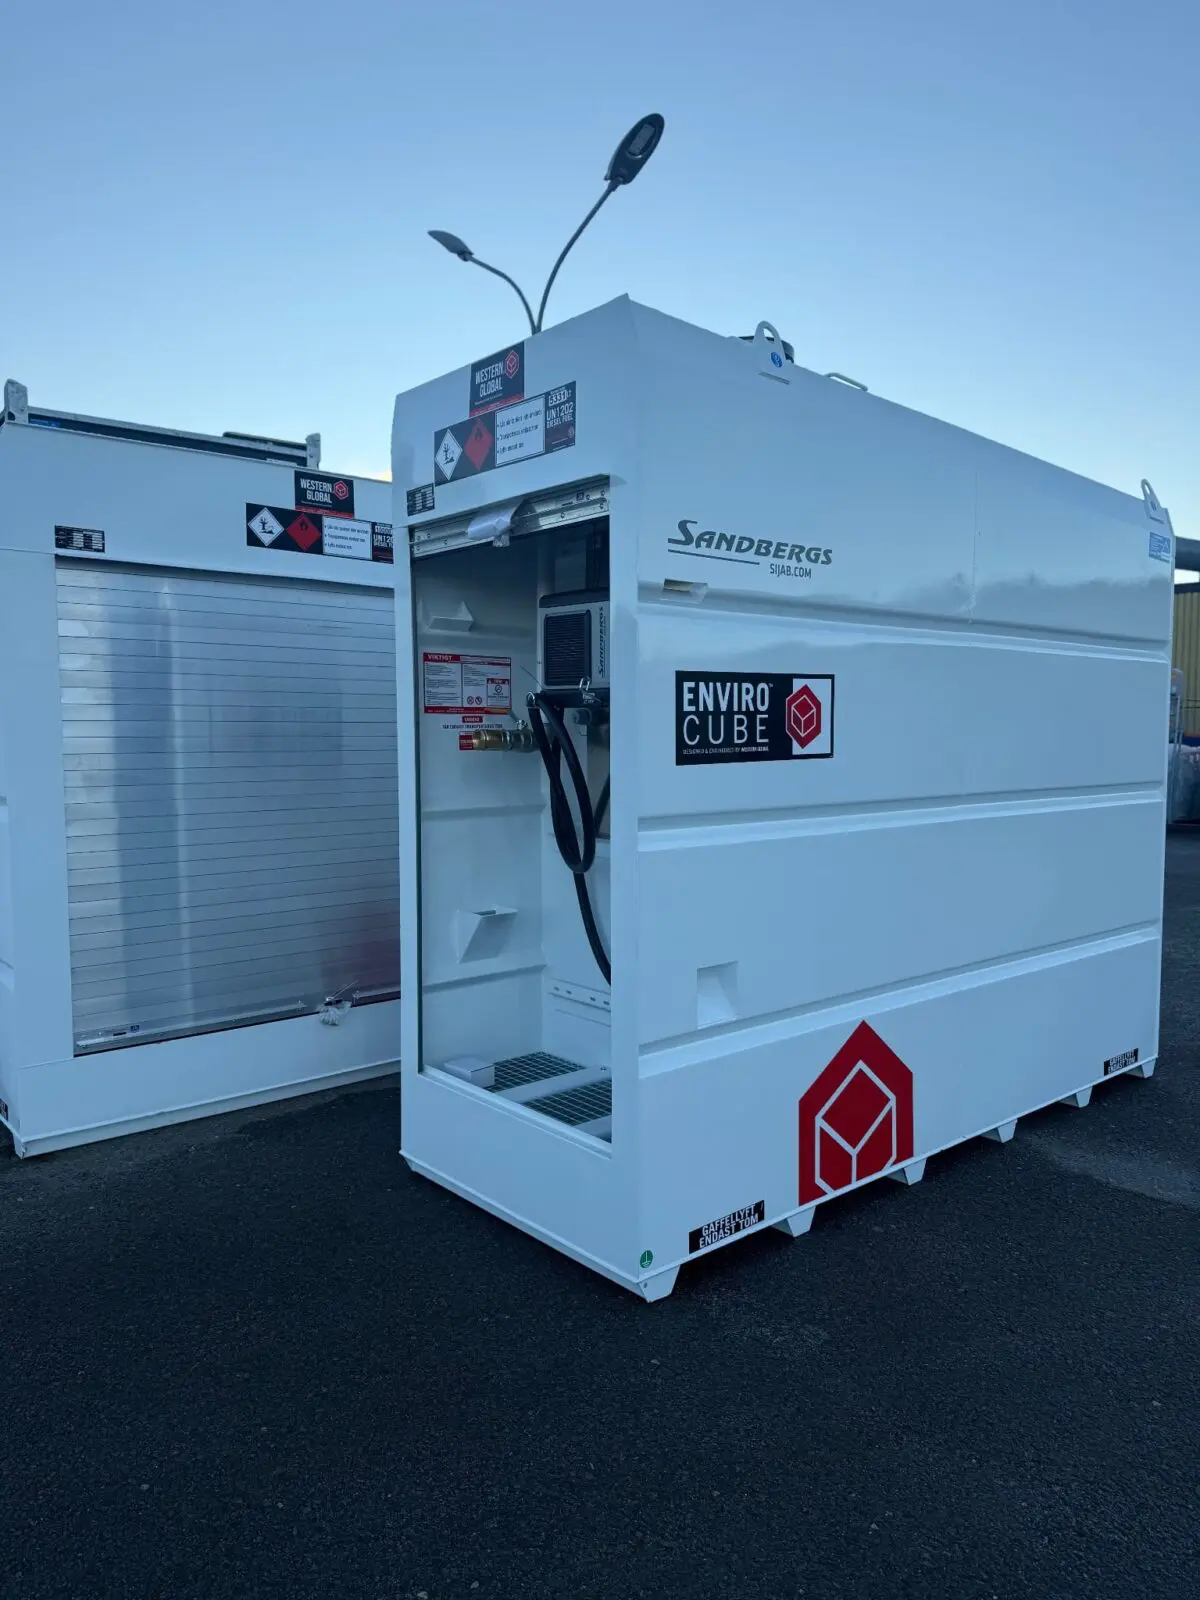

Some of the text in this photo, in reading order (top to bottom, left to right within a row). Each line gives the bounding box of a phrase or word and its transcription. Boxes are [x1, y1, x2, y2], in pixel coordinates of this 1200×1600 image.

[475, 361, 504, 385] WESTERN
[480, 377, 503, 397] GLOBAL
[300, 478, 332, 493] WESTERN
[306, 490, 332, 503] GLOBAL
[668, 519, 833, 565] SANDBERGS
[770, 563, 812, 579] SIJAB.COM
[682, 681, 770, 712] ENVIRO
[682, 714, 769, 745] CUBE
[699, 1212, 759, 1248] ENDAST TOM
[702, 1204, 755, 1236] GAFFELLYFT
